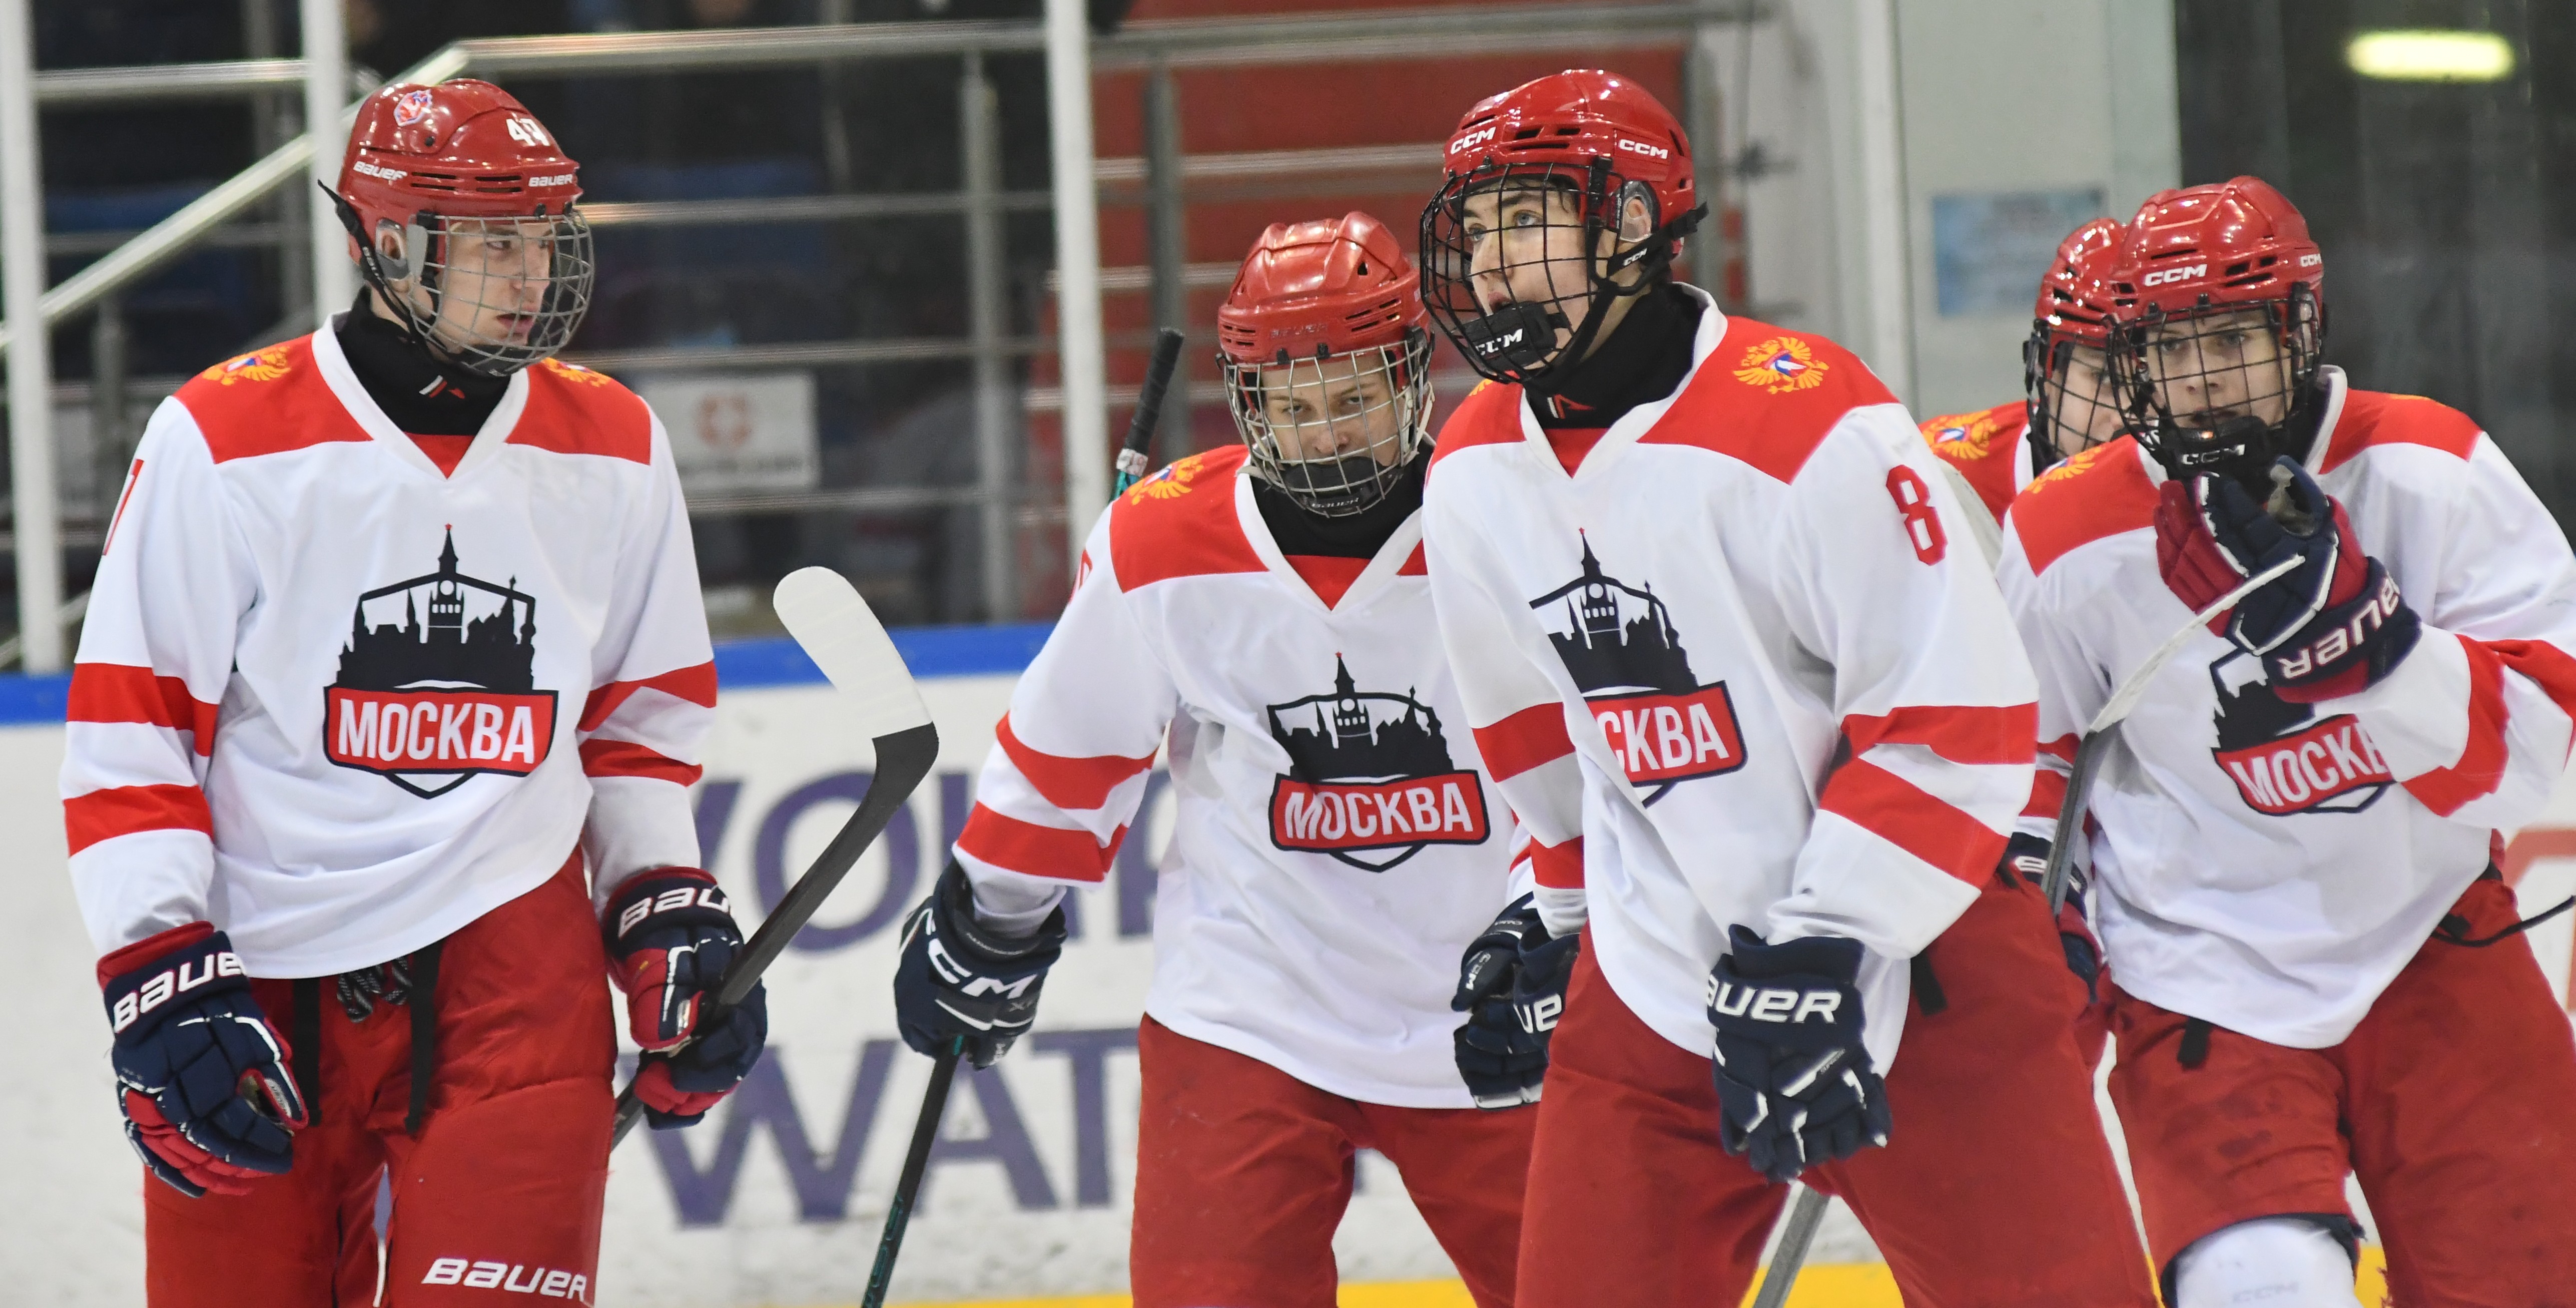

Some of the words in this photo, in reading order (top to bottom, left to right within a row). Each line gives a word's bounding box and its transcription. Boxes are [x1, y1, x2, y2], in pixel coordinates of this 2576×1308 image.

[1450, 126, 1496, 155] CCM
[1619, 139, 1668, 159] CCM
[528, 174, 573, 187] BAUER
[1623, 248, 1647, 266] CCM
[2144, 264, 2208, 286] CCM
[1885, 464, 1949, 567] 8
[338, 698, 535, 764] МОСКВА
[1597, 702, 1730, 773] СКВА
[1284, 782, 1474, 840] МОСКВА
[617, 887, 731, 940] BAU
[114, 952, 246, 1034] BAUE
[1706, 973, 1843, 1025] AUER
[421, 1257, 587, 1302] BAUER
